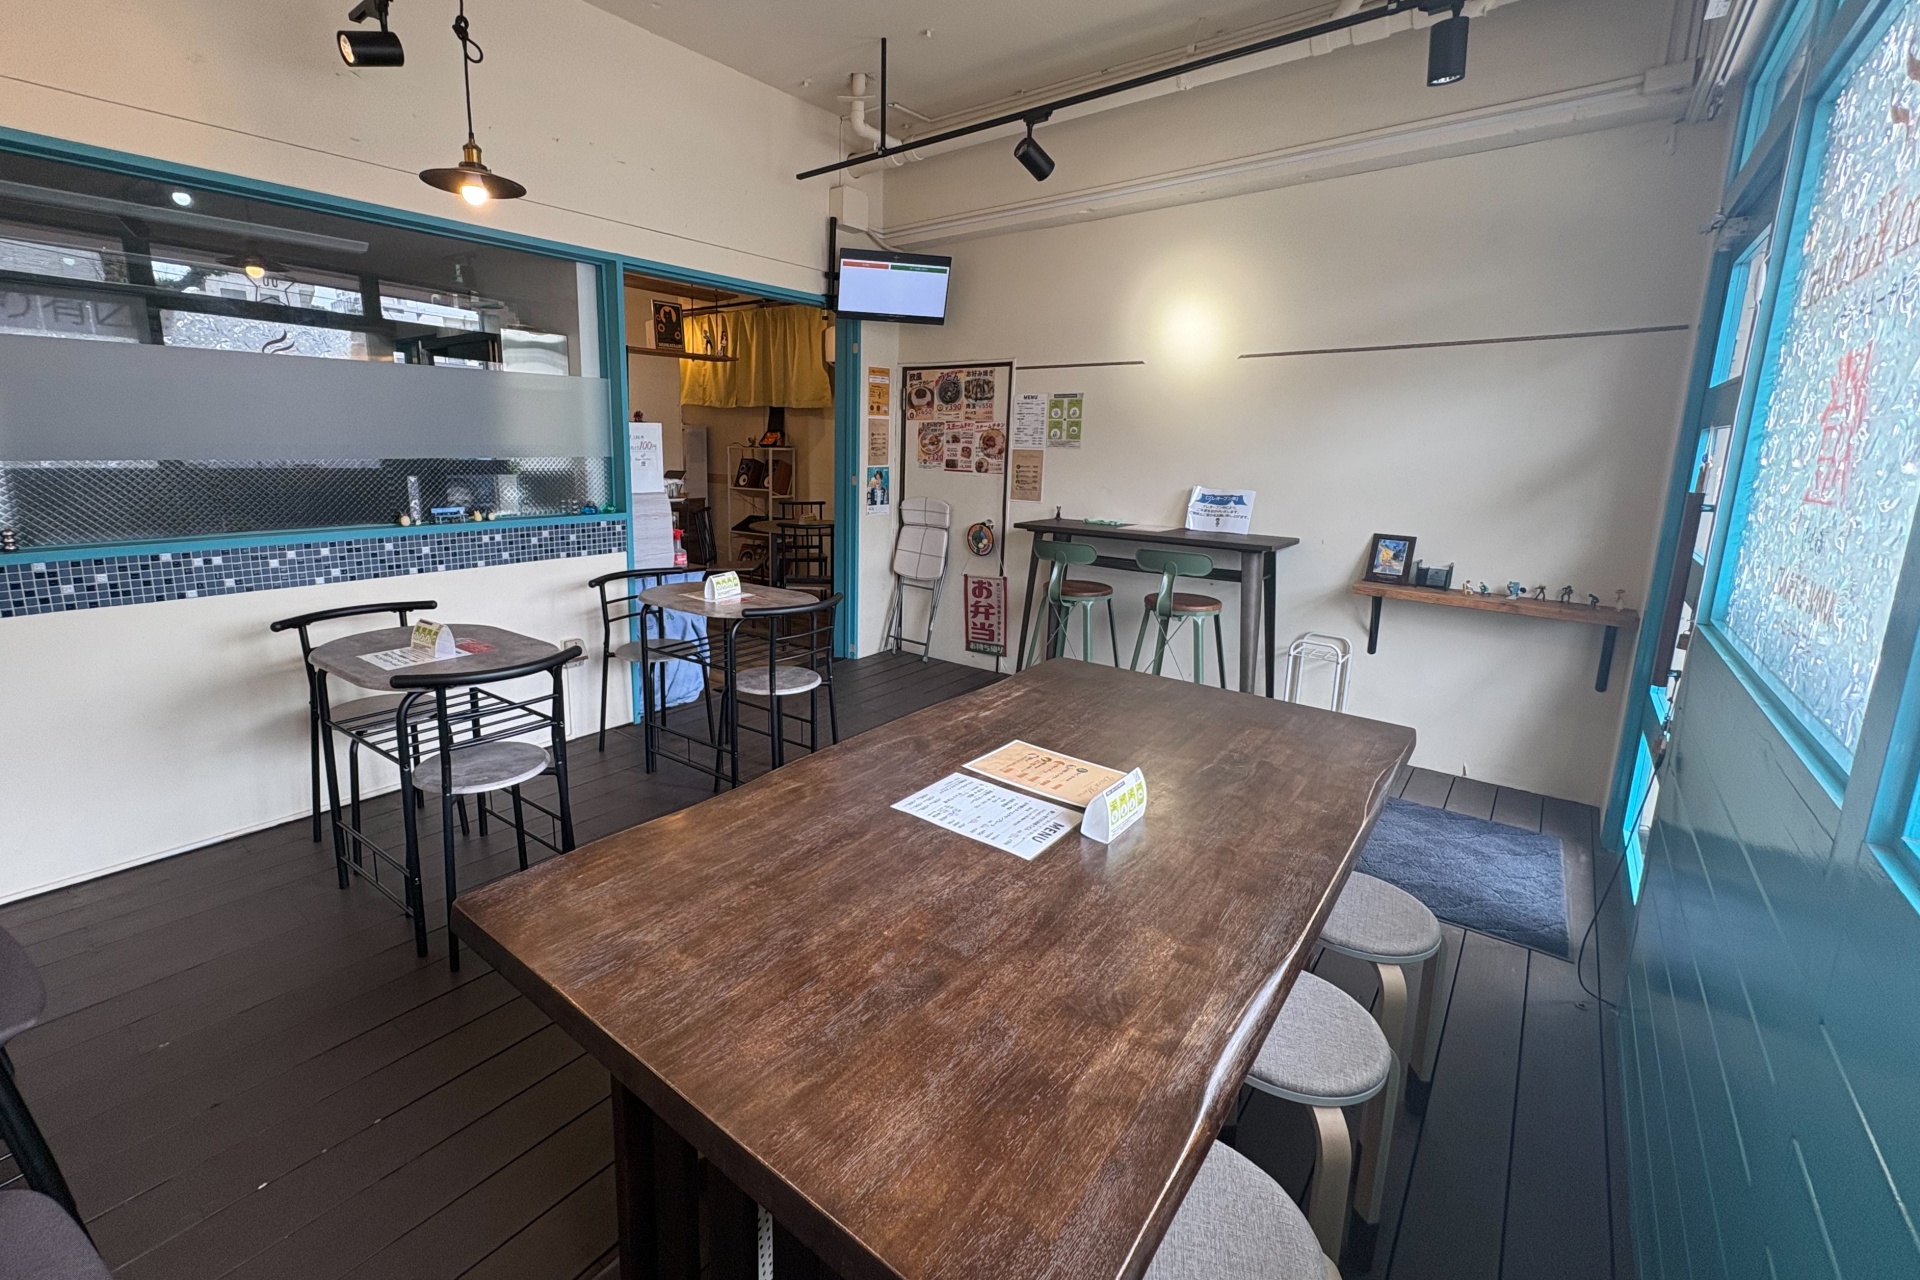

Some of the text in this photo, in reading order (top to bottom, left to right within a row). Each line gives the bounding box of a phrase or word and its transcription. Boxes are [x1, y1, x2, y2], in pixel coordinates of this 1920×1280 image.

[938, 372, 961, 381] うどん
[970, 580, 996, 642] お弁当
[1032, 821, 1065, 844] MENU
